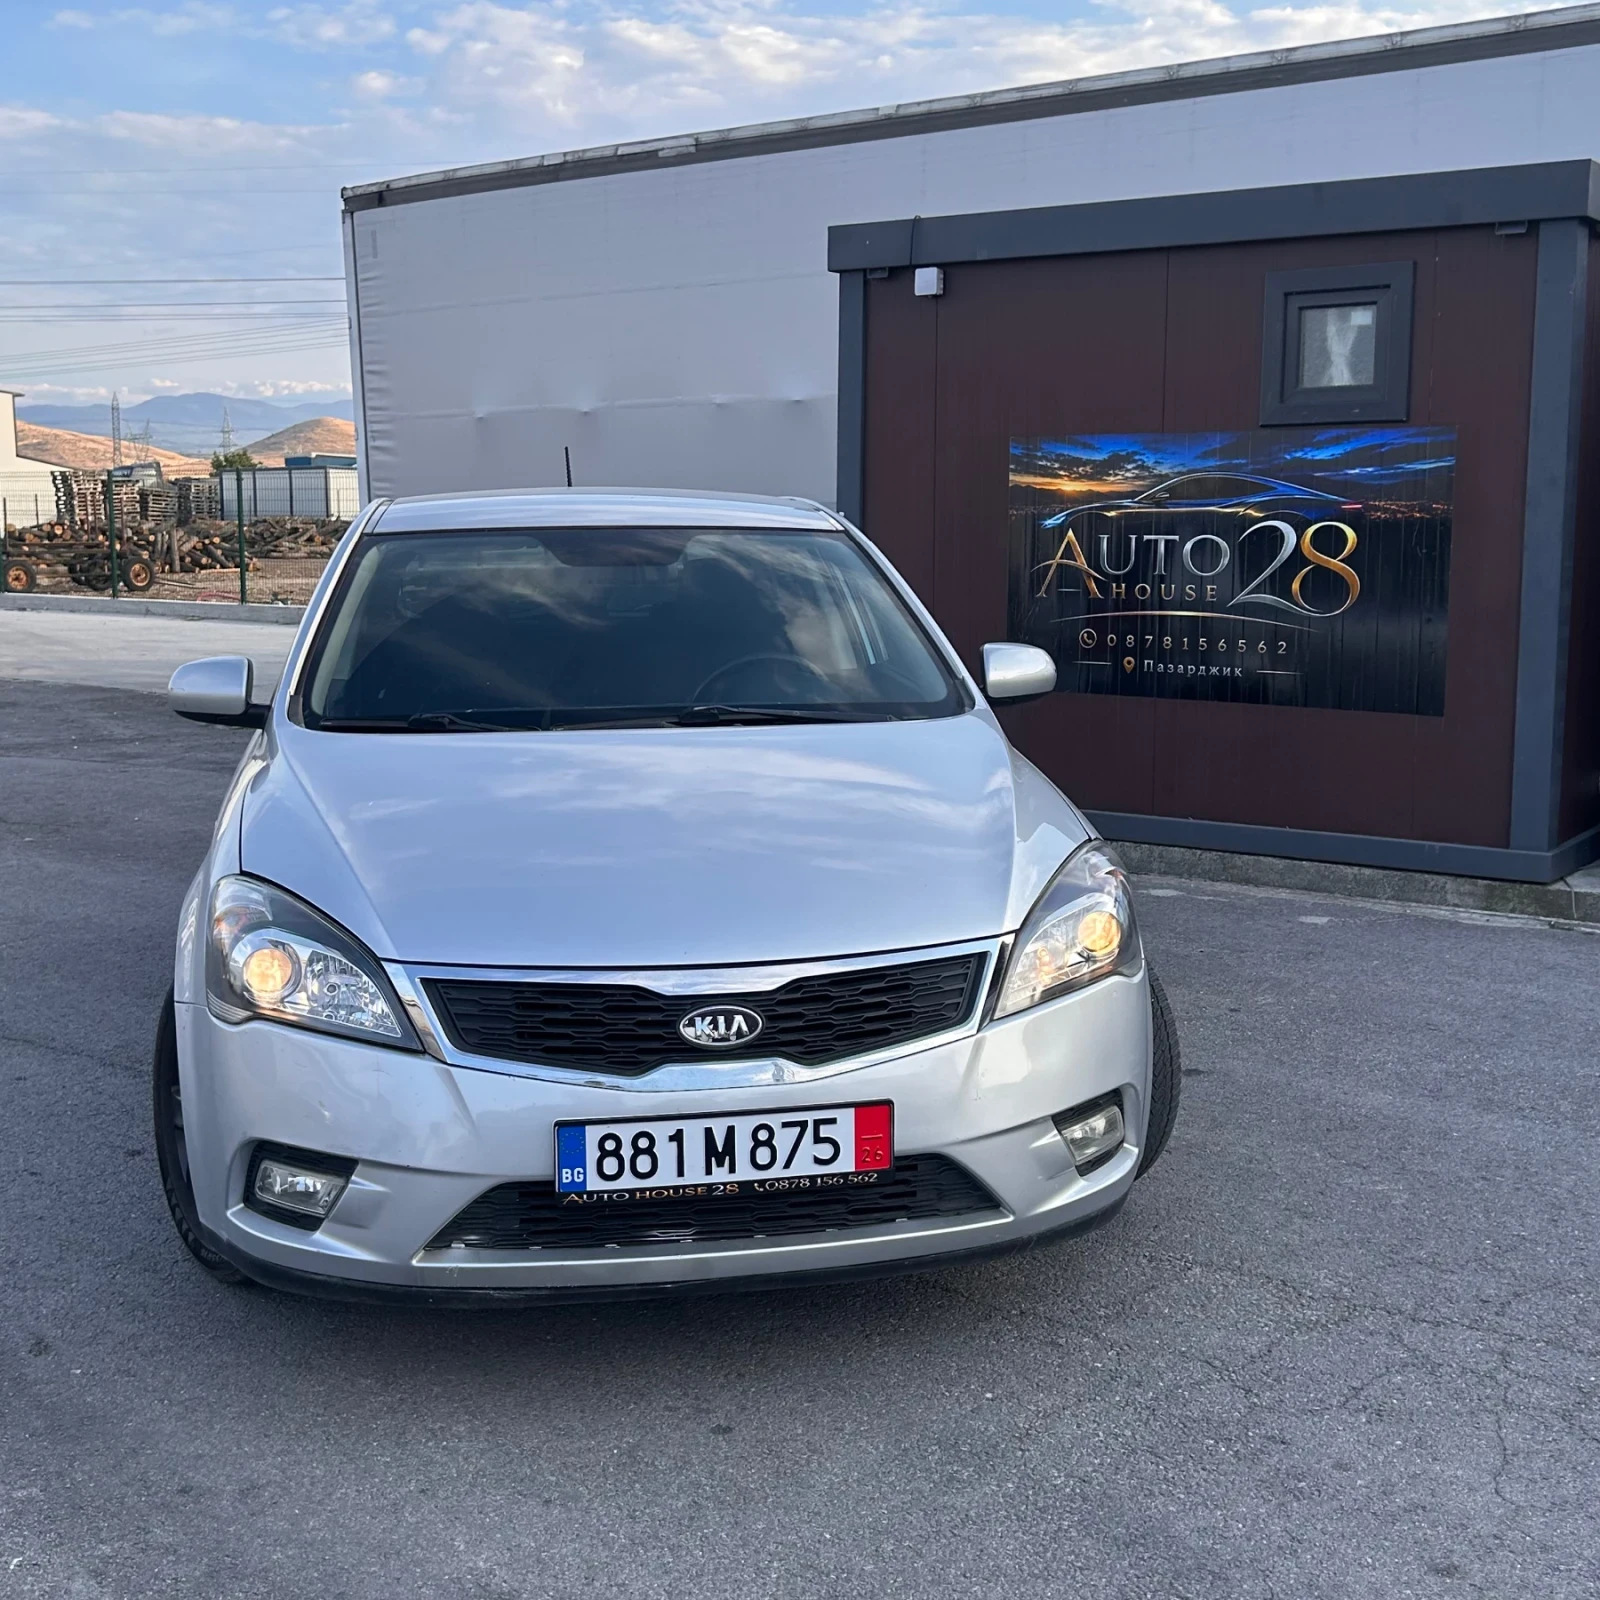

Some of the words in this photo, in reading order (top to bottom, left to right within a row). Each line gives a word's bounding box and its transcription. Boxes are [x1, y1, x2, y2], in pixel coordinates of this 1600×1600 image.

[1031, 528, 1230, 600] AUTO
[1227, 520, 1361, 617] 28
[1111, 584, 1218, 602] HOUSE
[1143, 659, 1244, 679] Пазарджик
[693, 1014, 750, 1038] KIA
[596, 1127, 686, 1182] 881
[704, 1125, 737, 1176] M
[749, 1117, 841, 1171] 875
[861, 1146, 884, 1163] 26
[562, 1167, 585, 1184] BG
[562, 1190, 629, 1205] AUTO
[635, 1186, 708, 1200] HOUSE
[712, 1183, 740, 1196] 28
